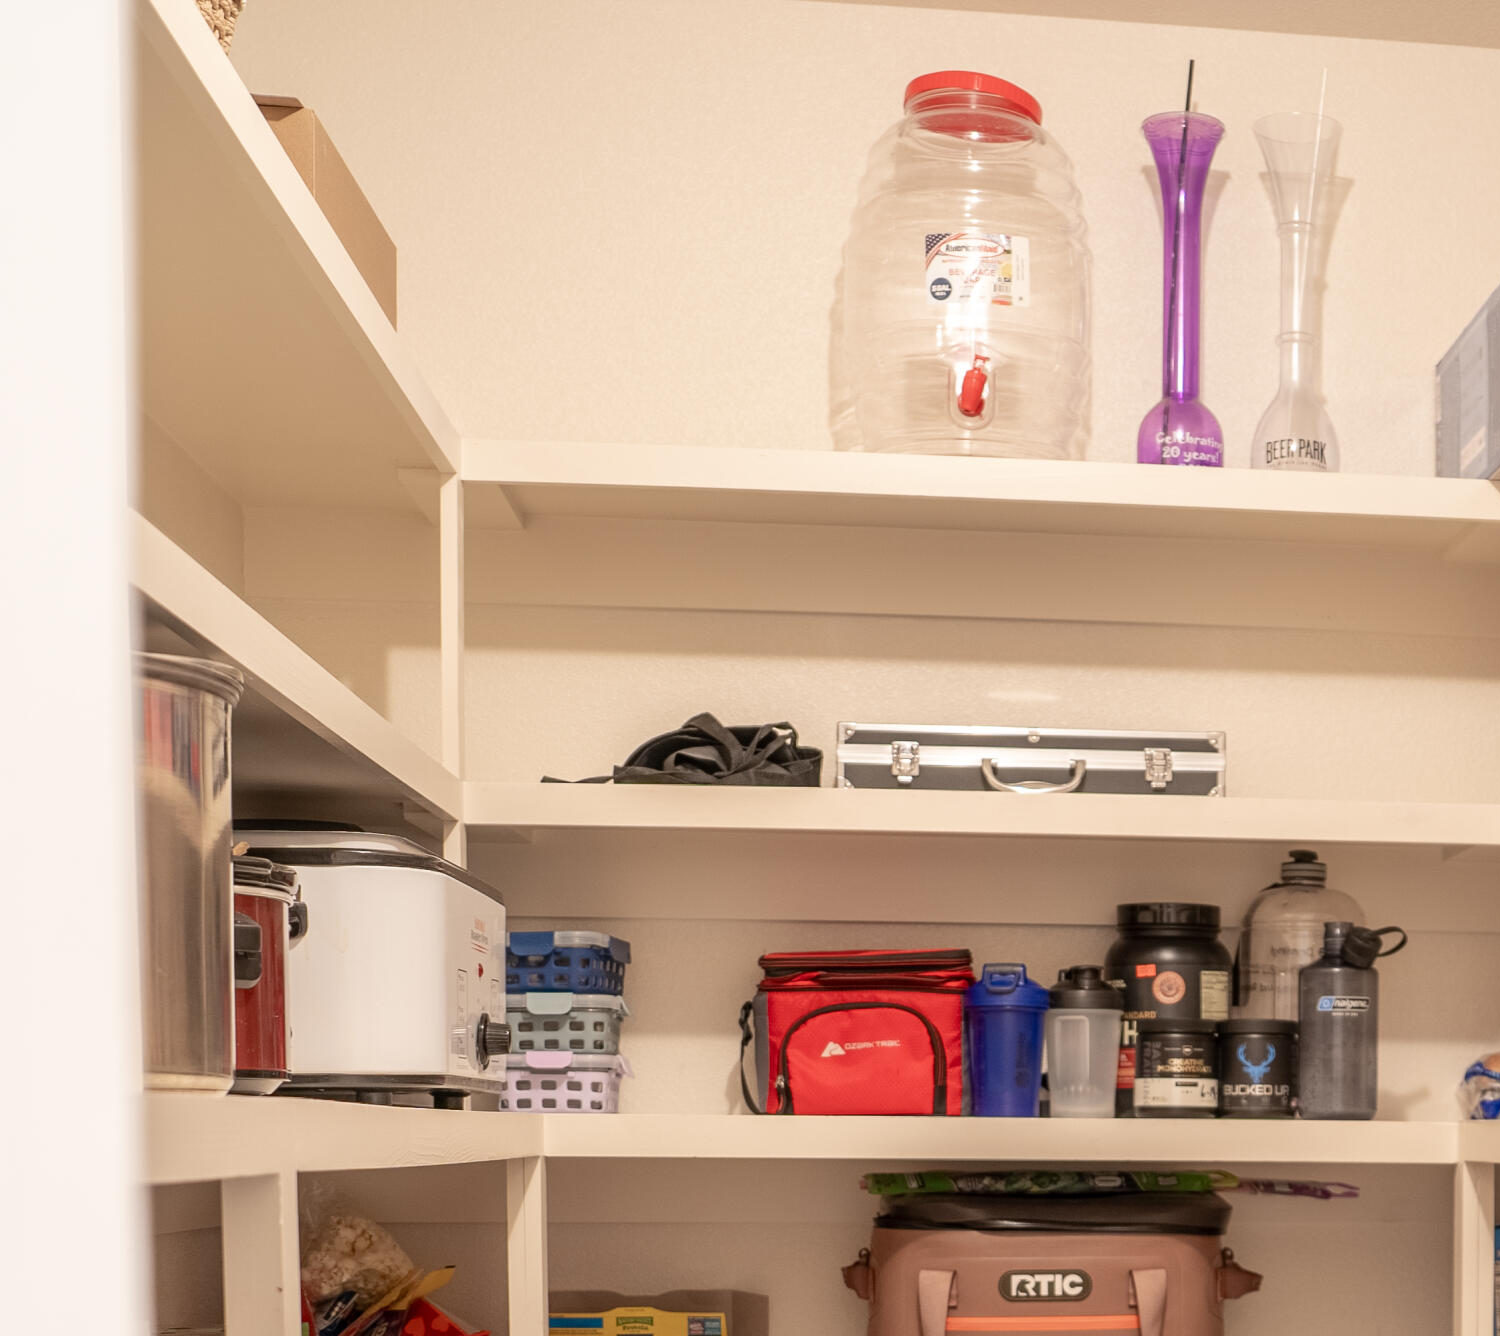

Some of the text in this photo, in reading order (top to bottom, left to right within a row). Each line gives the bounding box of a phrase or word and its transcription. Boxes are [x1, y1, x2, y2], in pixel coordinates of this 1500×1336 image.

[1162, 446, 1219, 464] 20 years!
[1266, 438, 1327, 465] BEER PARK
[1223, 1084, 1290, 1096] BUCKED UP
[1011, 1274, 1084, 1297] RTIC
